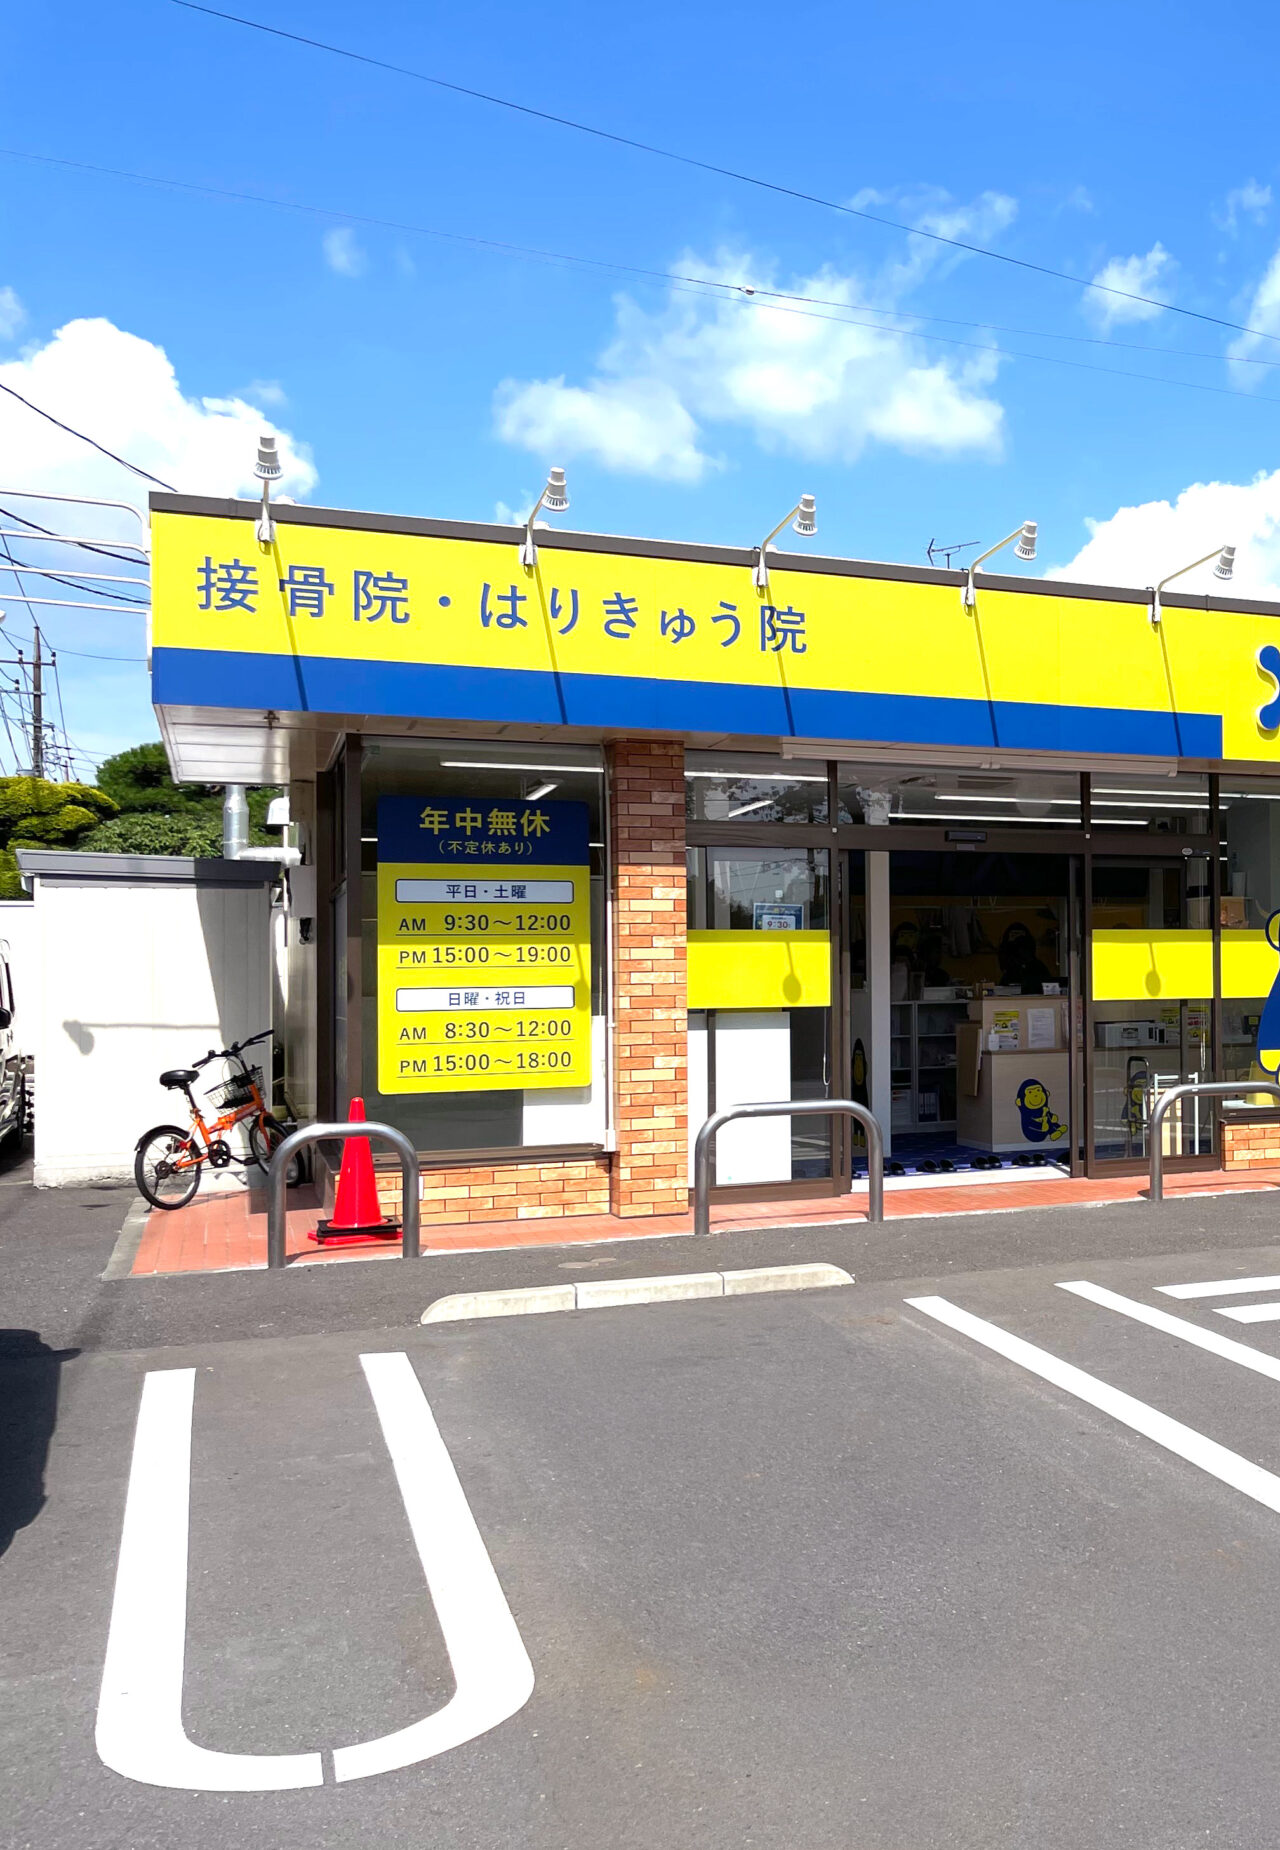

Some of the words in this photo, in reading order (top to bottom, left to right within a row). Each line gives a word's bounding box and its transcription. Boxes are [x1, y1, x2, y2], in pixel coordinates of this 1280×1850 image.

[196, 556, 807, 653] 接骨院・はりきゅう院
[419, 806, 551, 837] 年中無休
[438, 840, 533, 856] （不定休あり）
[446, 884, 527, 899] 平日・土曜
[398, 917, 426, 931] AM
[399, 950, 426, 964] PM
[448, 991, 526, 1006] 日曜・祝日
[399, 1027, 427, 1040] AM
[399, 1059, 427, 1073] PM
